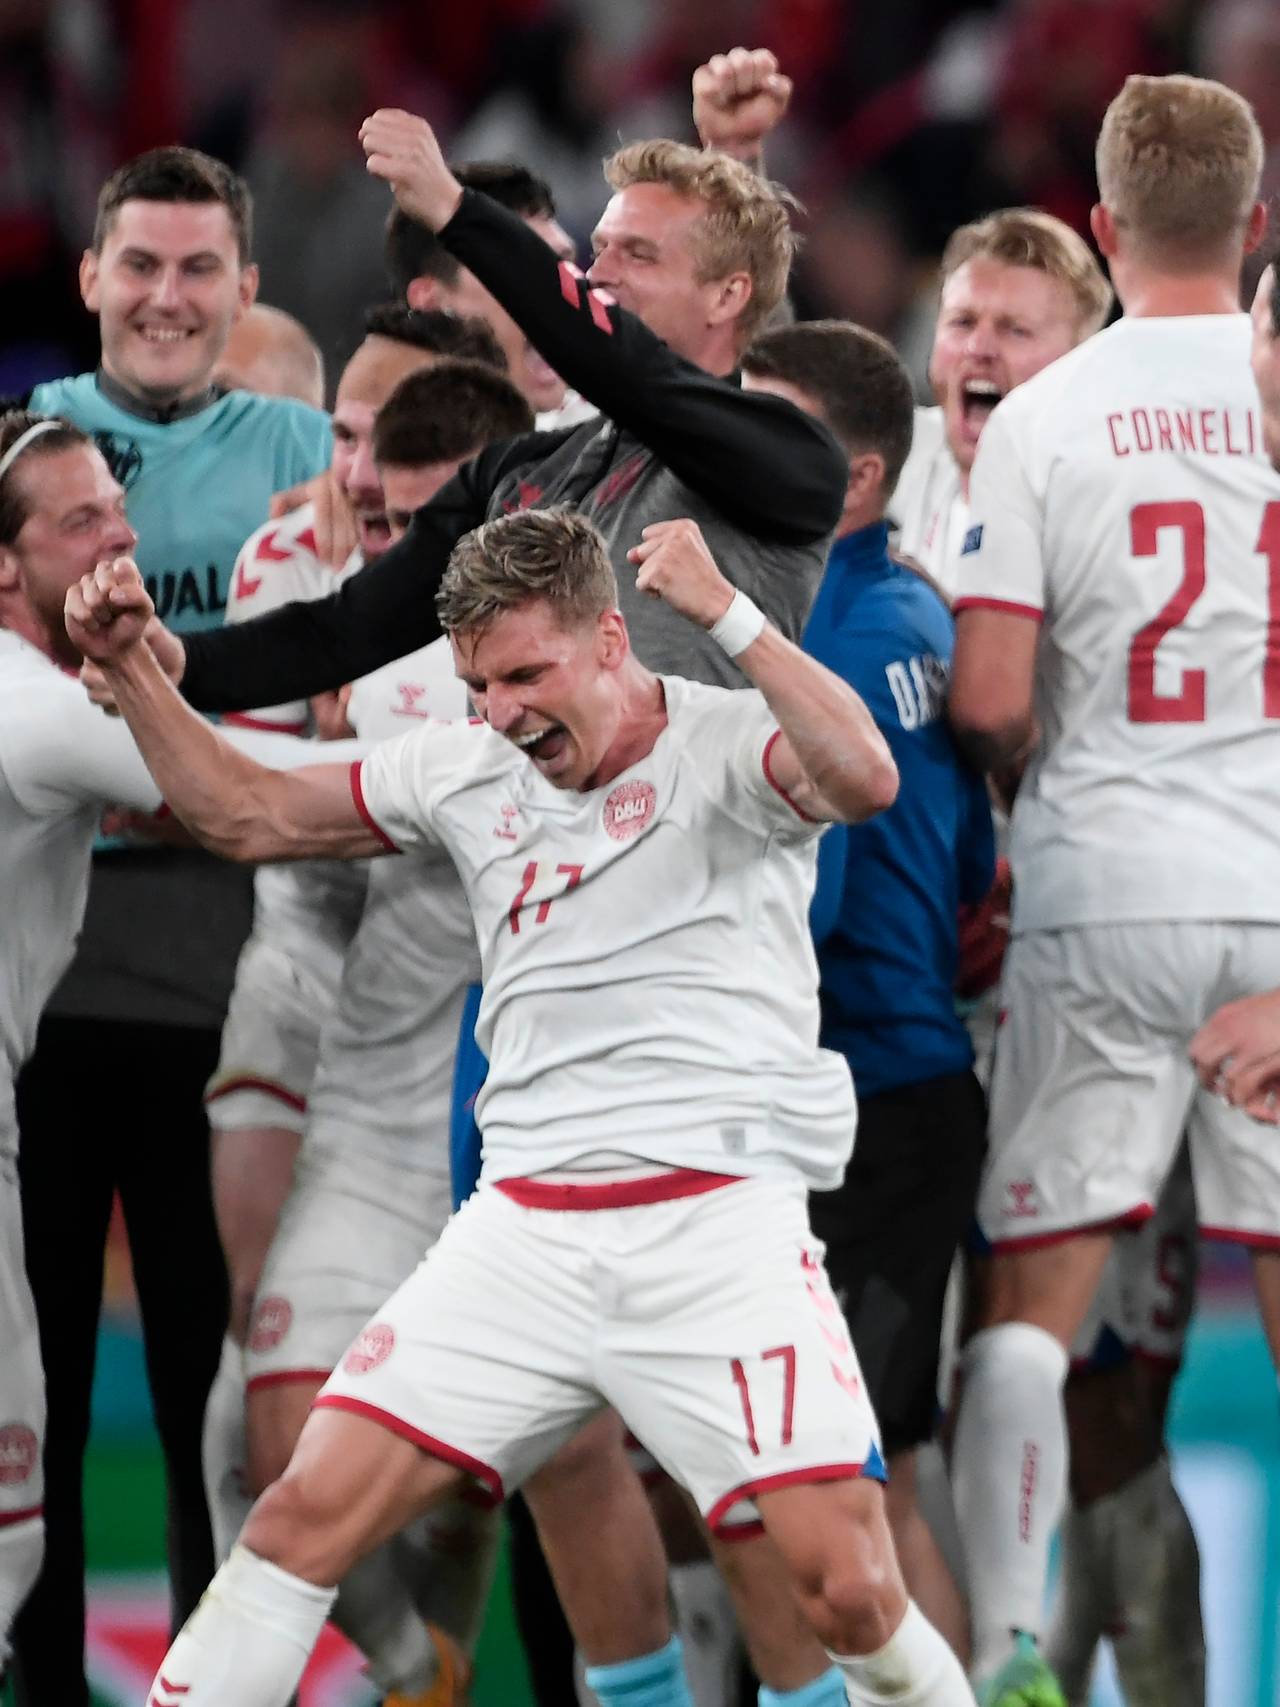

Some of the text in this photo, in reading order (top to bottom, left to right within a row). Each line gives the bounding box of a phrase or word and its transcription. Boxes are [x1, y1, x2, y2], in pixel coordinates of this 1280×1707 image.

[1107, 407, 1268, 457] CORNELI
[509, 861, 585, 935] 17
[730, 1345, 796, 1456] 17
